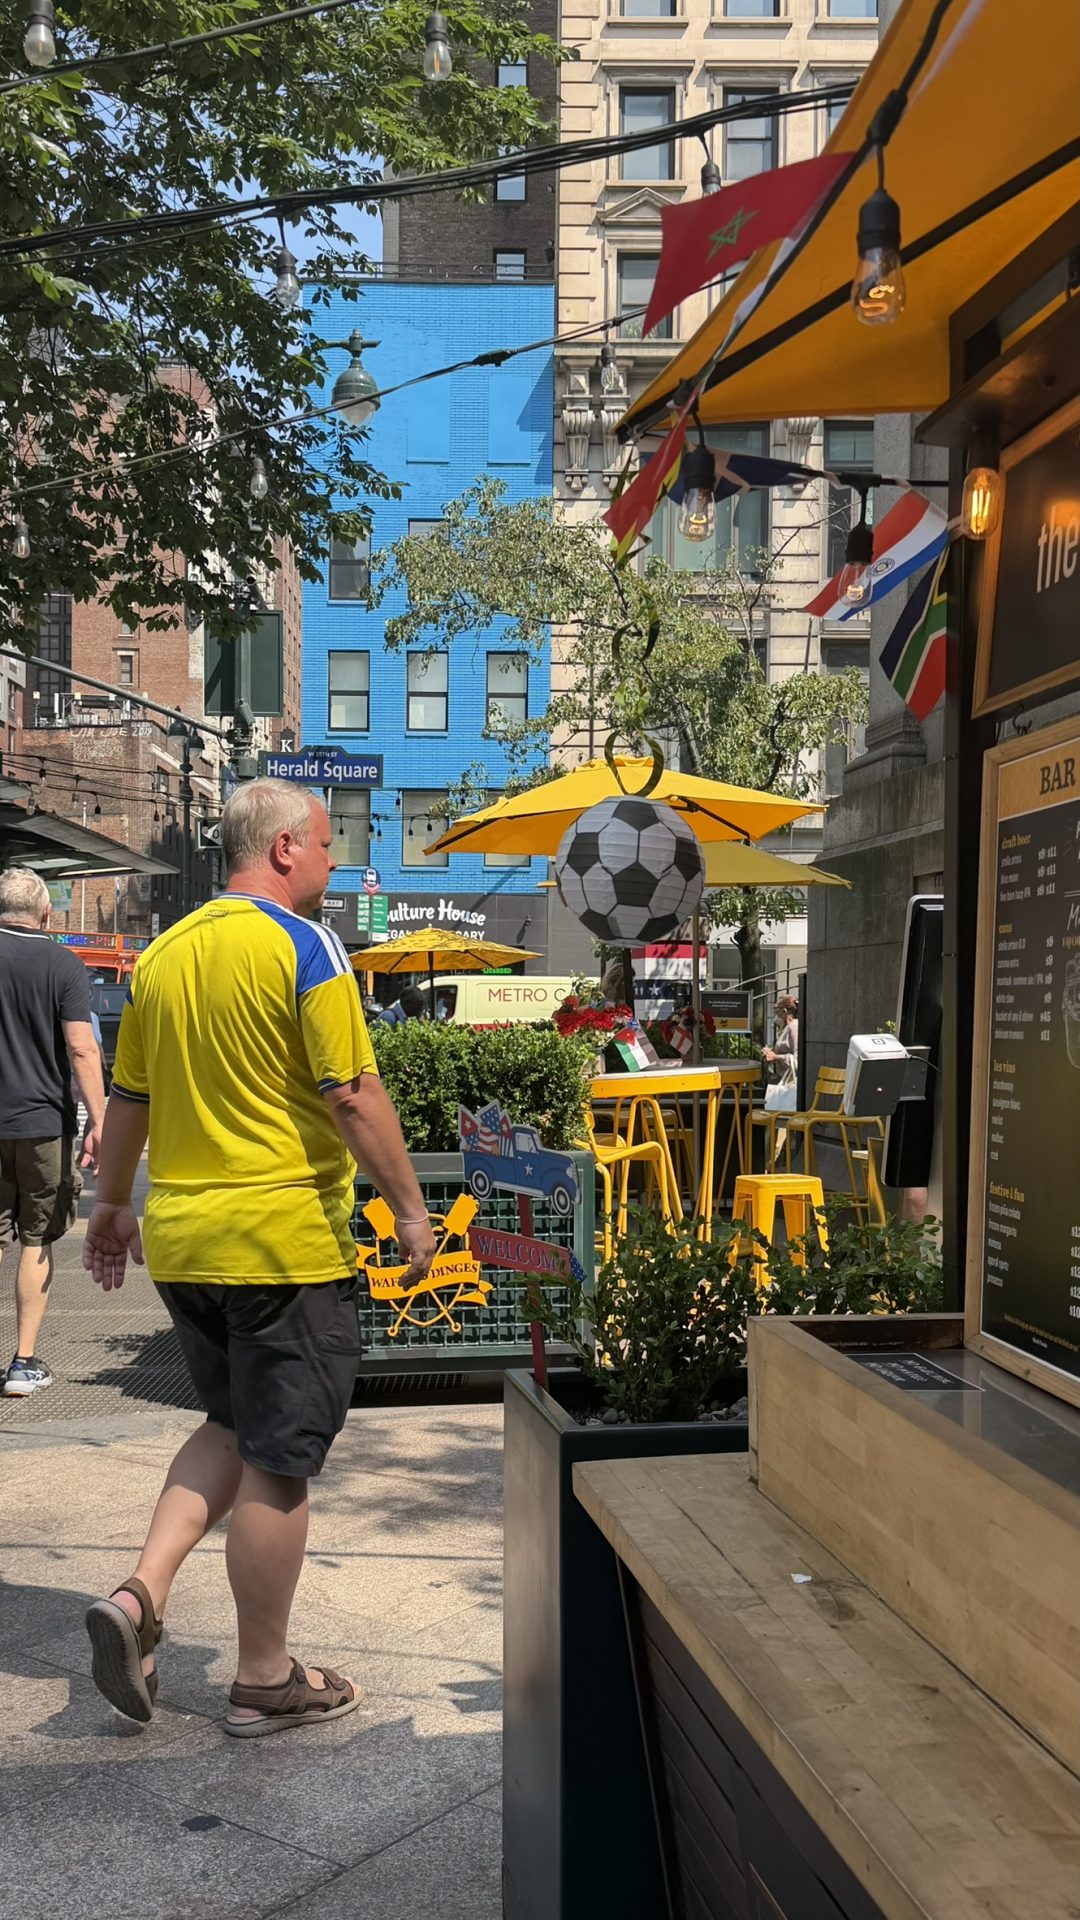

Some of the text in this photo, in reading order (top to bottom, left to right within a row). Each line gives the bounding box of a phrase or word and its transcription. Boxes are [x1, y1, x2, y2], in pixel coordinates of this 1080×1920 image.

[1036, 505, 1080, 593] the
[267, 760, 378, 782] Herald Square
[1040, 757, 1076, 795] BAR
[387, 902, 434, 923] ulture
[437, 898, 486, 926] House
[488, 988, 547, 1002] METRO
[431, 1262, 478, 1278] DINGES
